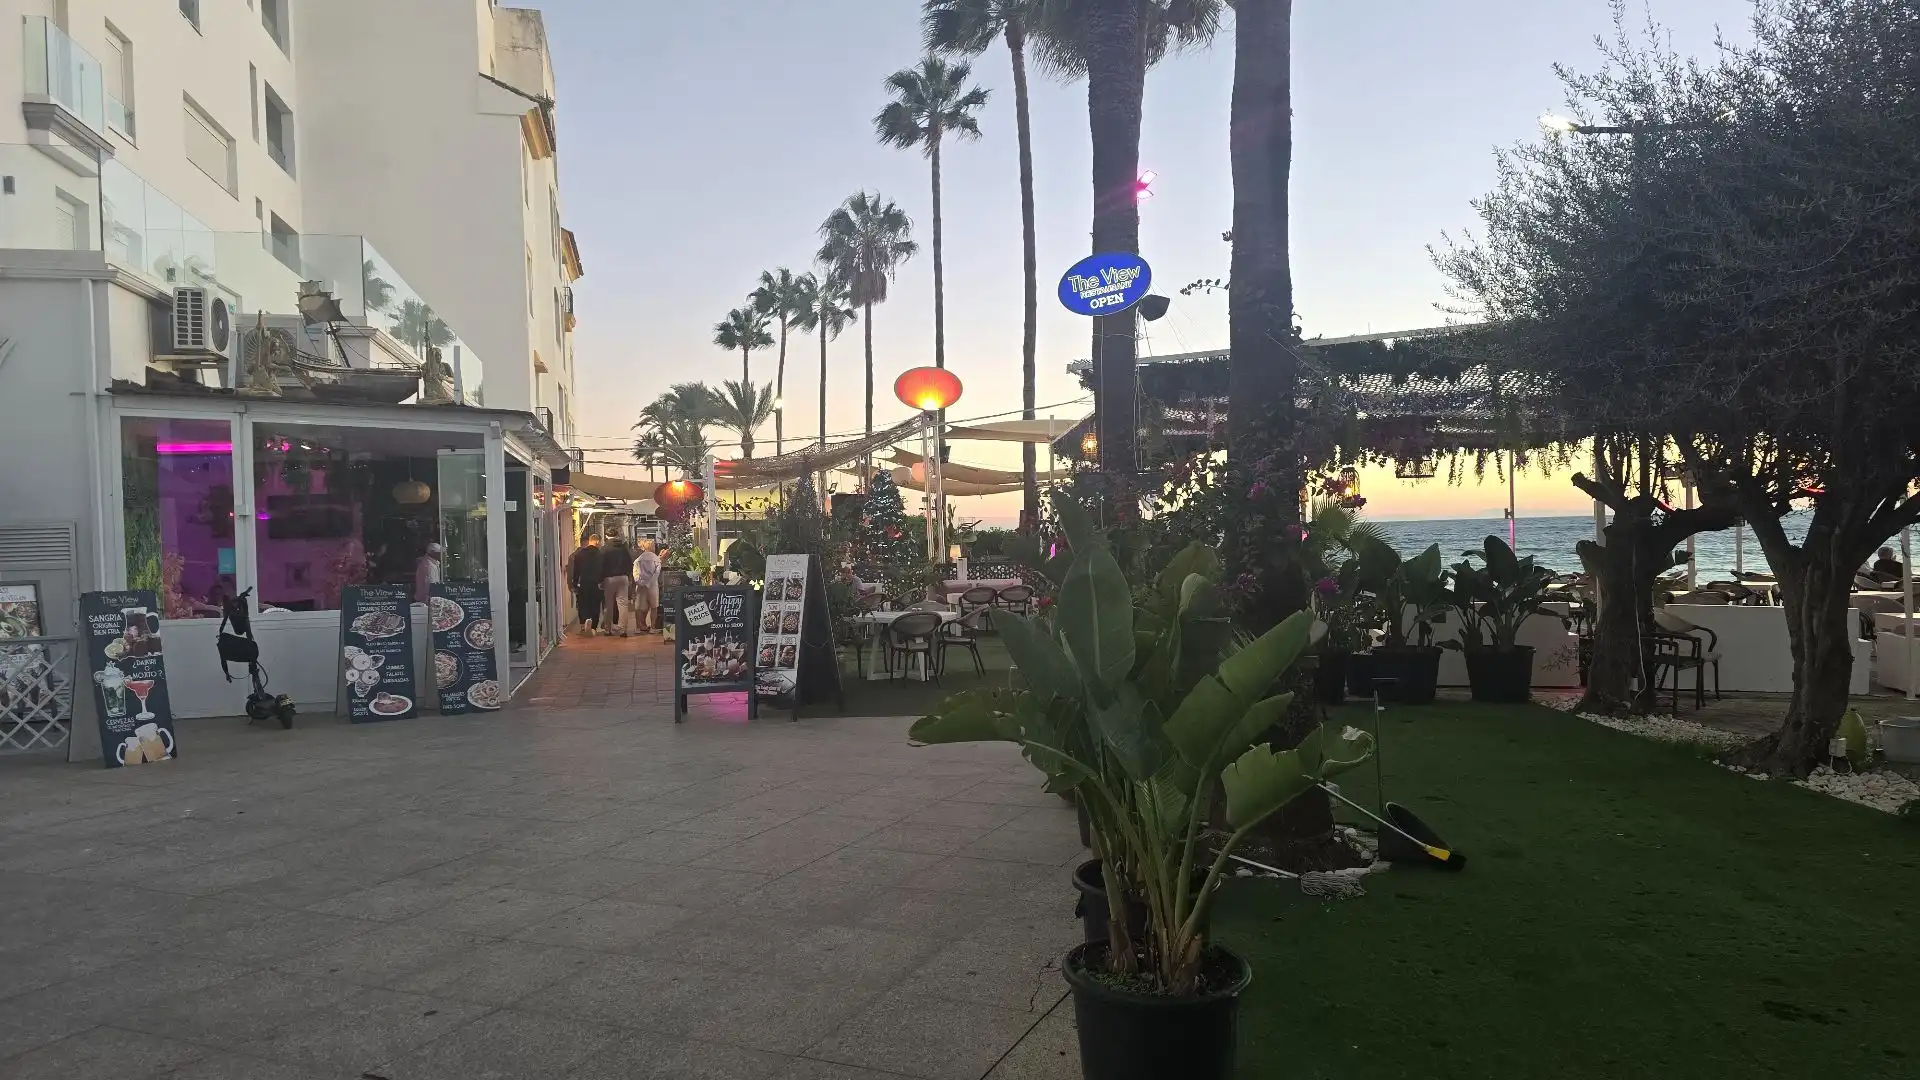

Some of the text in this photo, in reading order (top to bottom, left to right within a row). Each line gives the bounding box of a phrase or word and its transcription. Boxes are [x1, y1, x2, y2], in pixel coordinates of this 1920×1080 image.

[1068, 266, 1140, 292] The View
[1090, 293, 1124, 309] OPEN
[360, 589, 374, 597] The
[375, 589, 393, 597] View
[100, 595, 139, 604] The View
[709, 593, 745, 610] Happy
[688, 605, 705, 616] HALF
[717, 605, 741, 616] Hour
[88, 613, 123, 623] SANGRIA
[689, 611, 710, 623] PRICE
[105, 716, 135, 726] CERVEZAS
